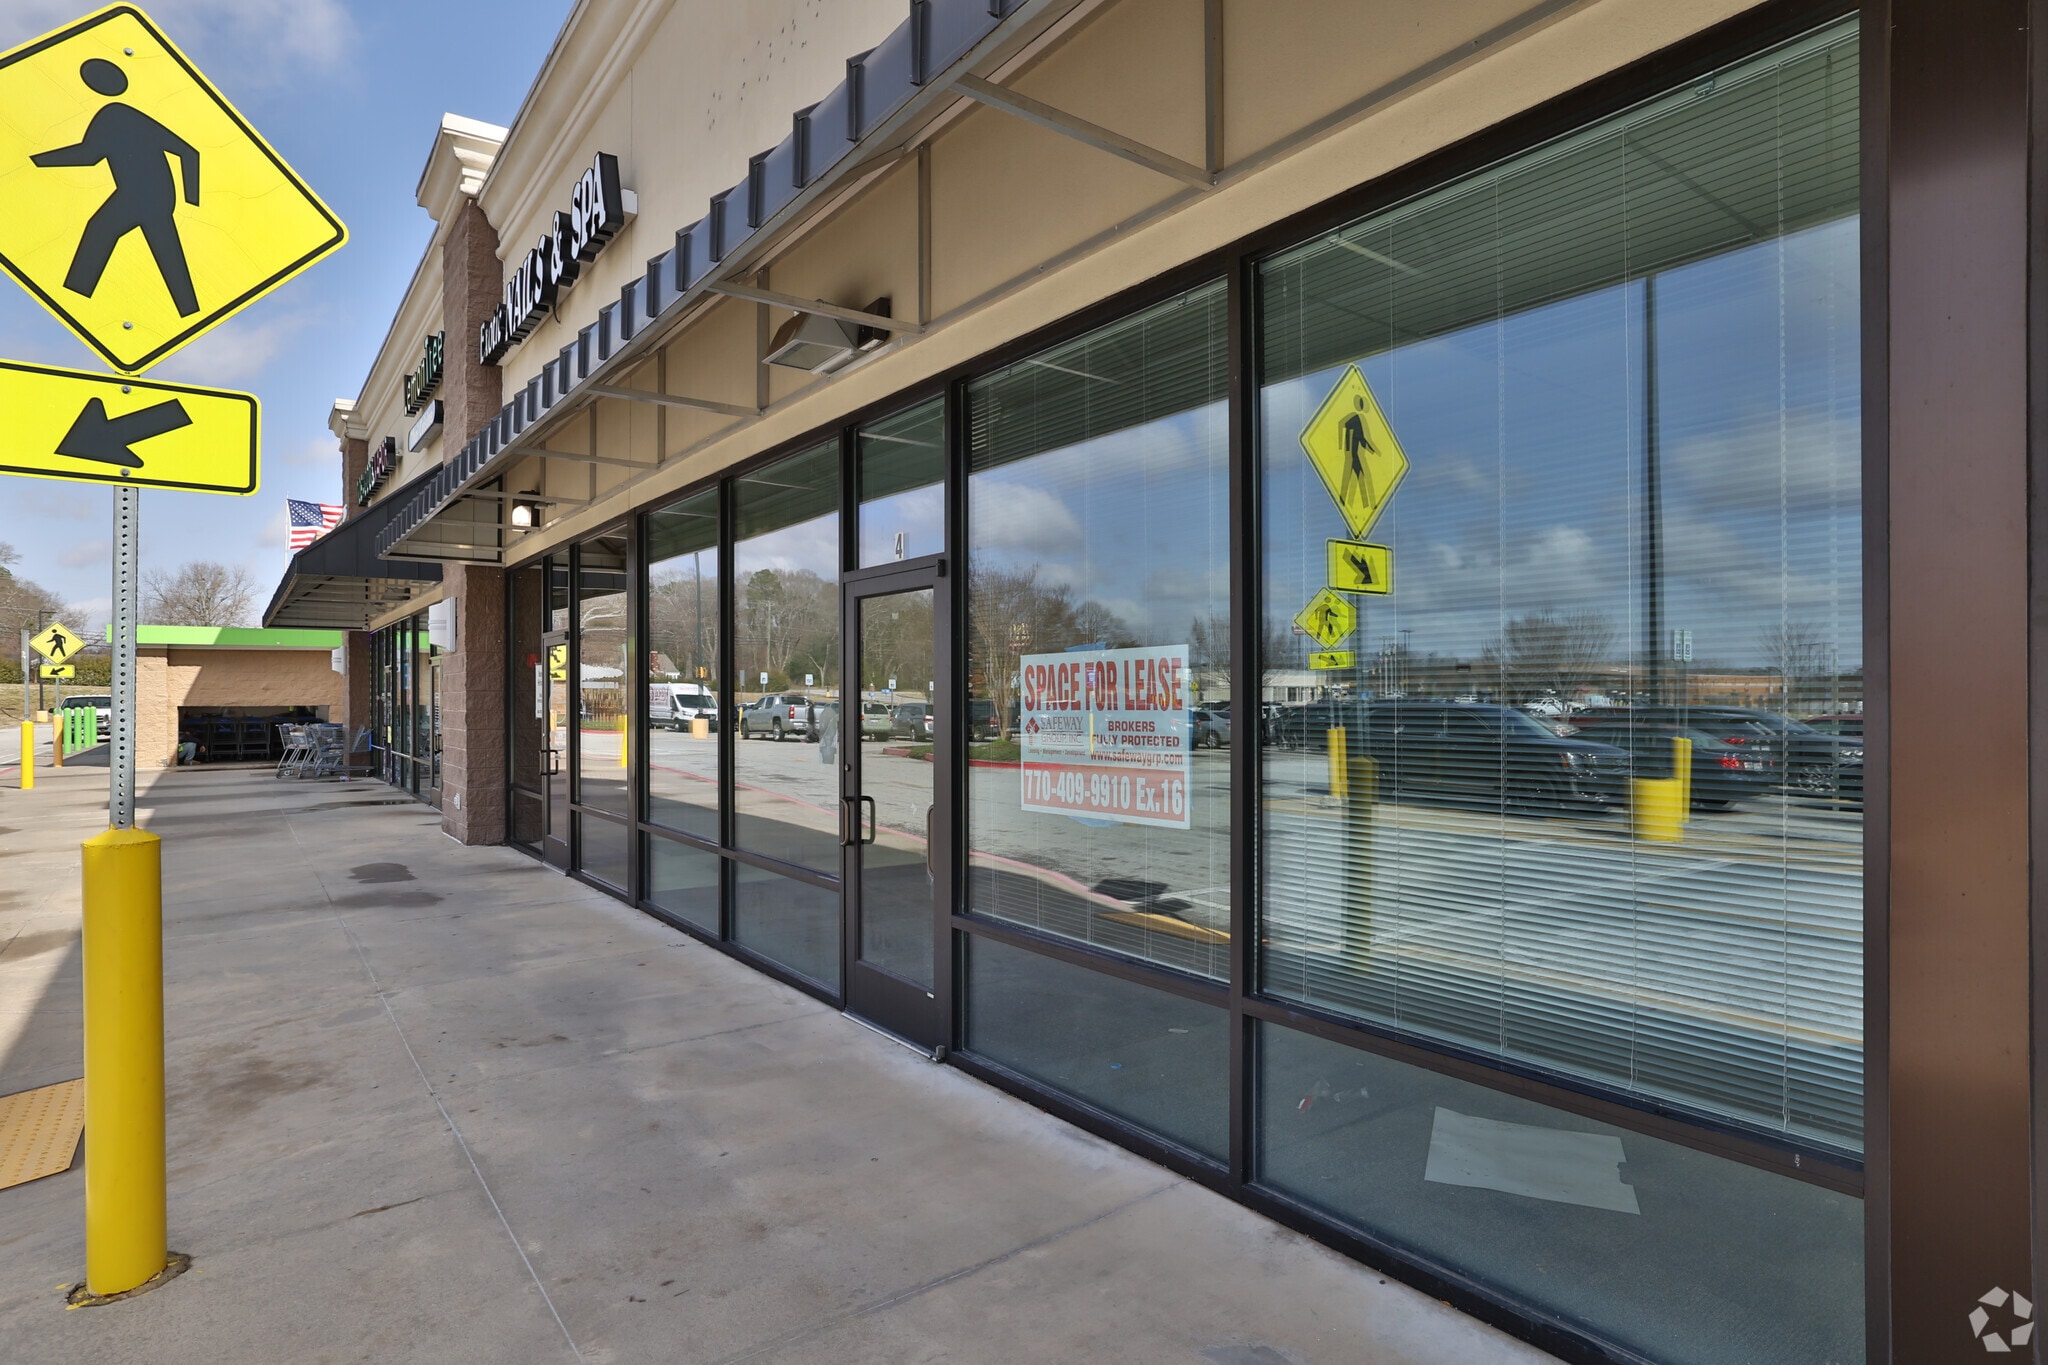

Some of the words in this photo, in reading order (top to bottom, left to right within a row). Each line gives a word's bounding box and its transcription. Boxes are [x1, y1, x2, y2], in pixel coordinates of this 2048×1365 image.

[505, 233, 547, 342] NAILS
[551, 210, 564, 286] &
[571, 152, 607, 260] SPA
[895, 533, 903, 559] 4
[1024, 662, 1081, 712] SPACE
[1085, 660, 1119, 711] FOR
[1124, 657, 1183, 711] LEASE
[1040, 716, 1083, 731] SAFEWAY
[1108, 720, 1156, 732] BROKERS
[1092, 734, 1119, 745] FULLY
[1121, 735, 1180, 747] PROTECTED
[1091, 749, 1183, 767] www.safewaygrp.com
[1025, 769, 1131, 810] 770-409-9910
